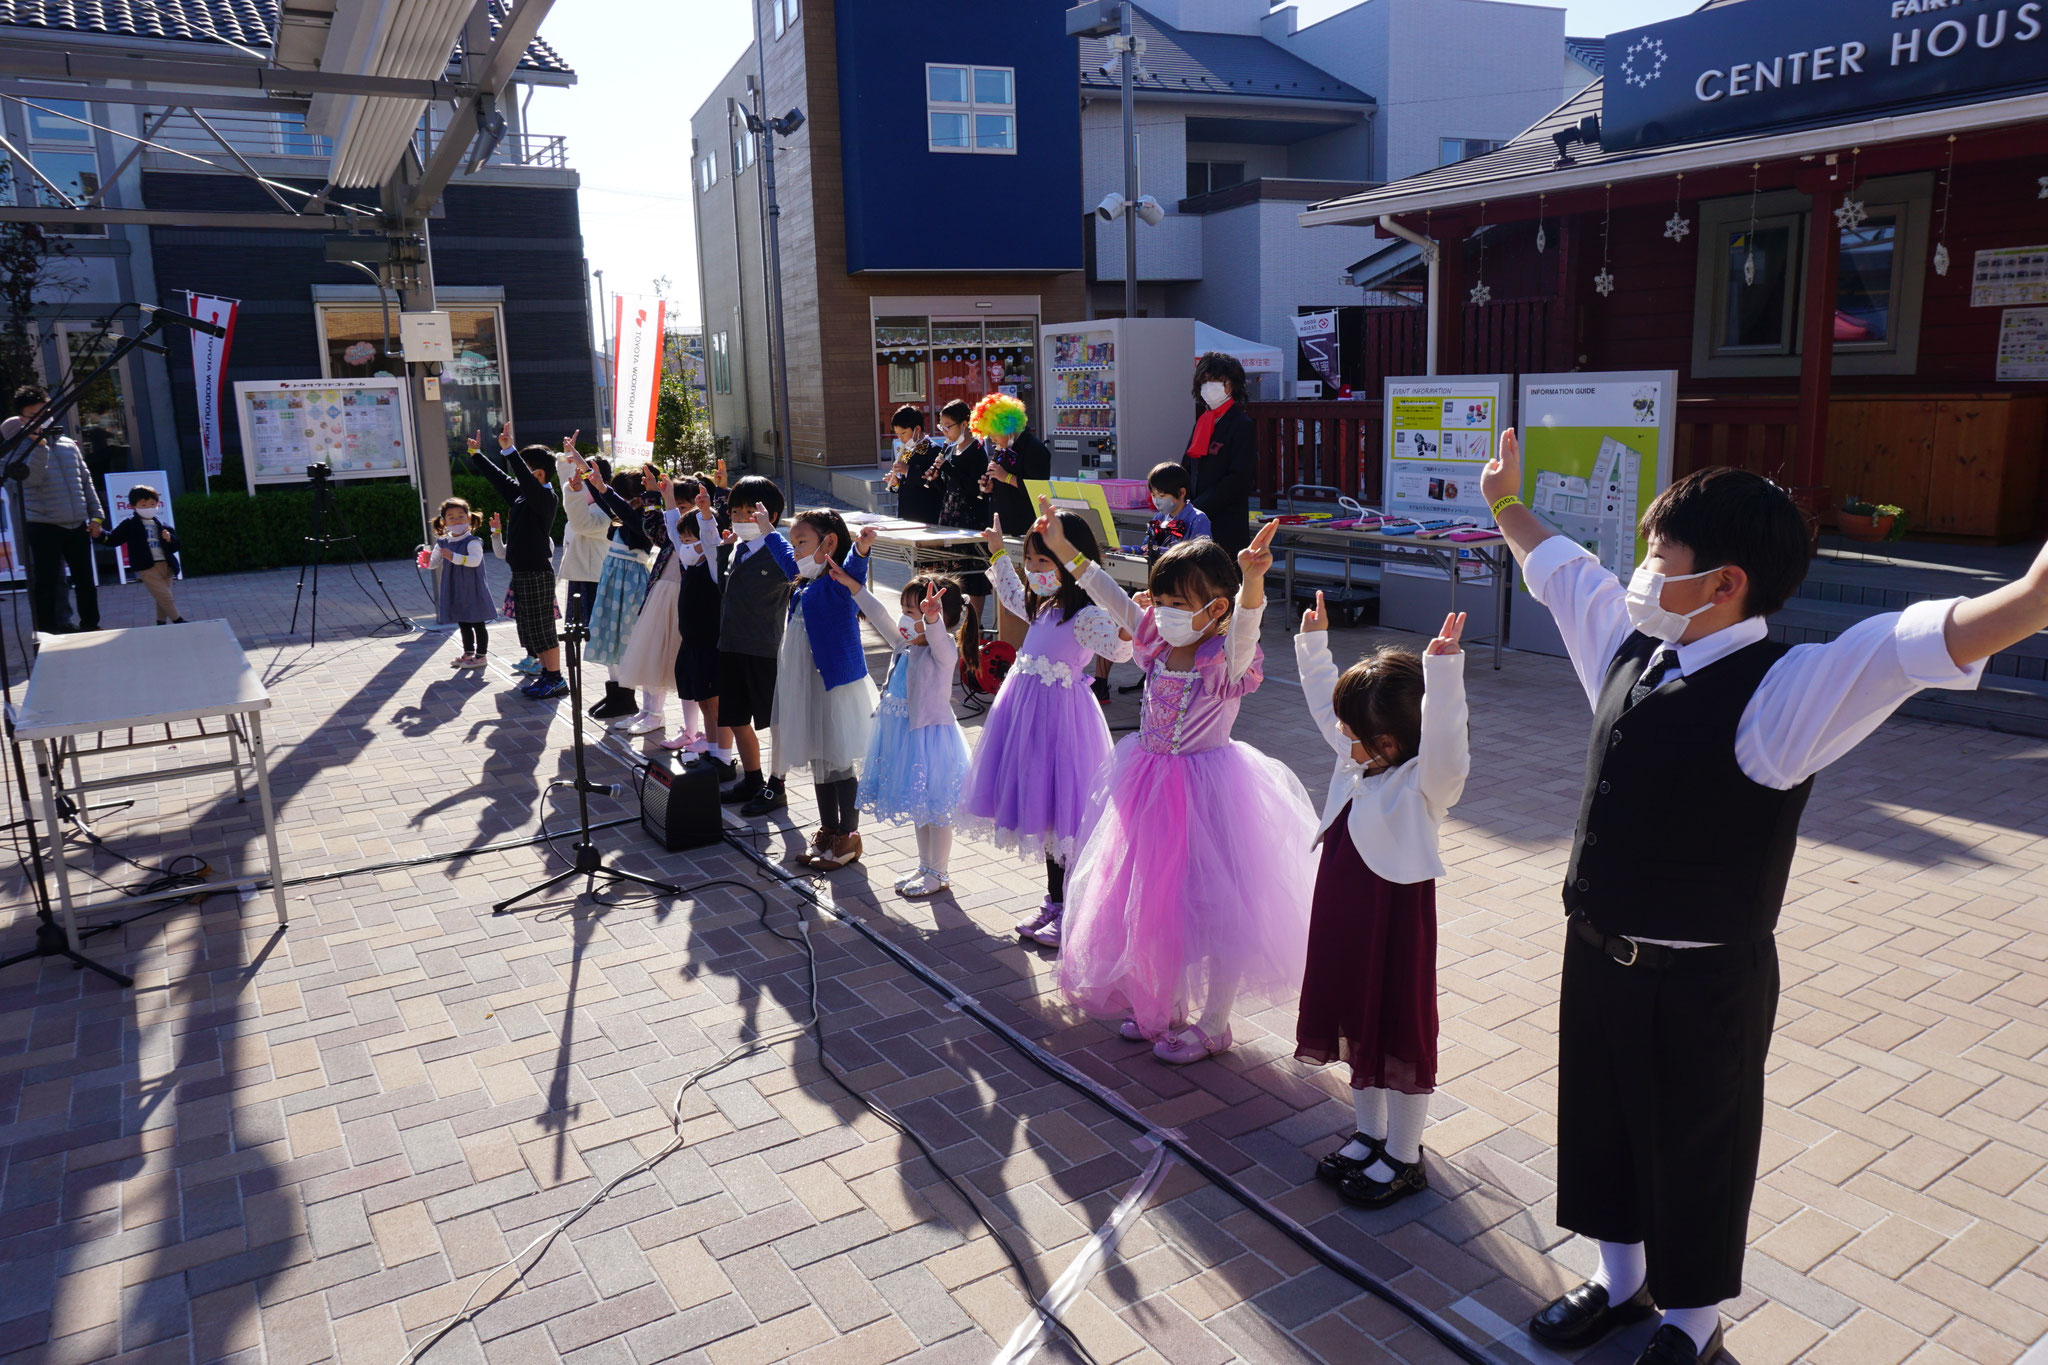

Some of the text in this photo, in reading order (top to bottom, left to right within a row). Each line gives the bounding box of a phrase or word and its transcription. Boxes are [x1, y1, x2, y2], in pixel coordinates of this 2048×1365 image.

[1891, 0, 1961, 18] FAIR
[1695, 41, 1865, 101] CENTER
[206, 337, 214, 374] TOYOTA
[633, 331, 641, 363] TOYOTA
[628, 365, 638, 409] WOODYOU
[1412, 387, 1452, 395] INFORMATION
[1531, 387, 1596, 396] INFORMATION GUIDE
